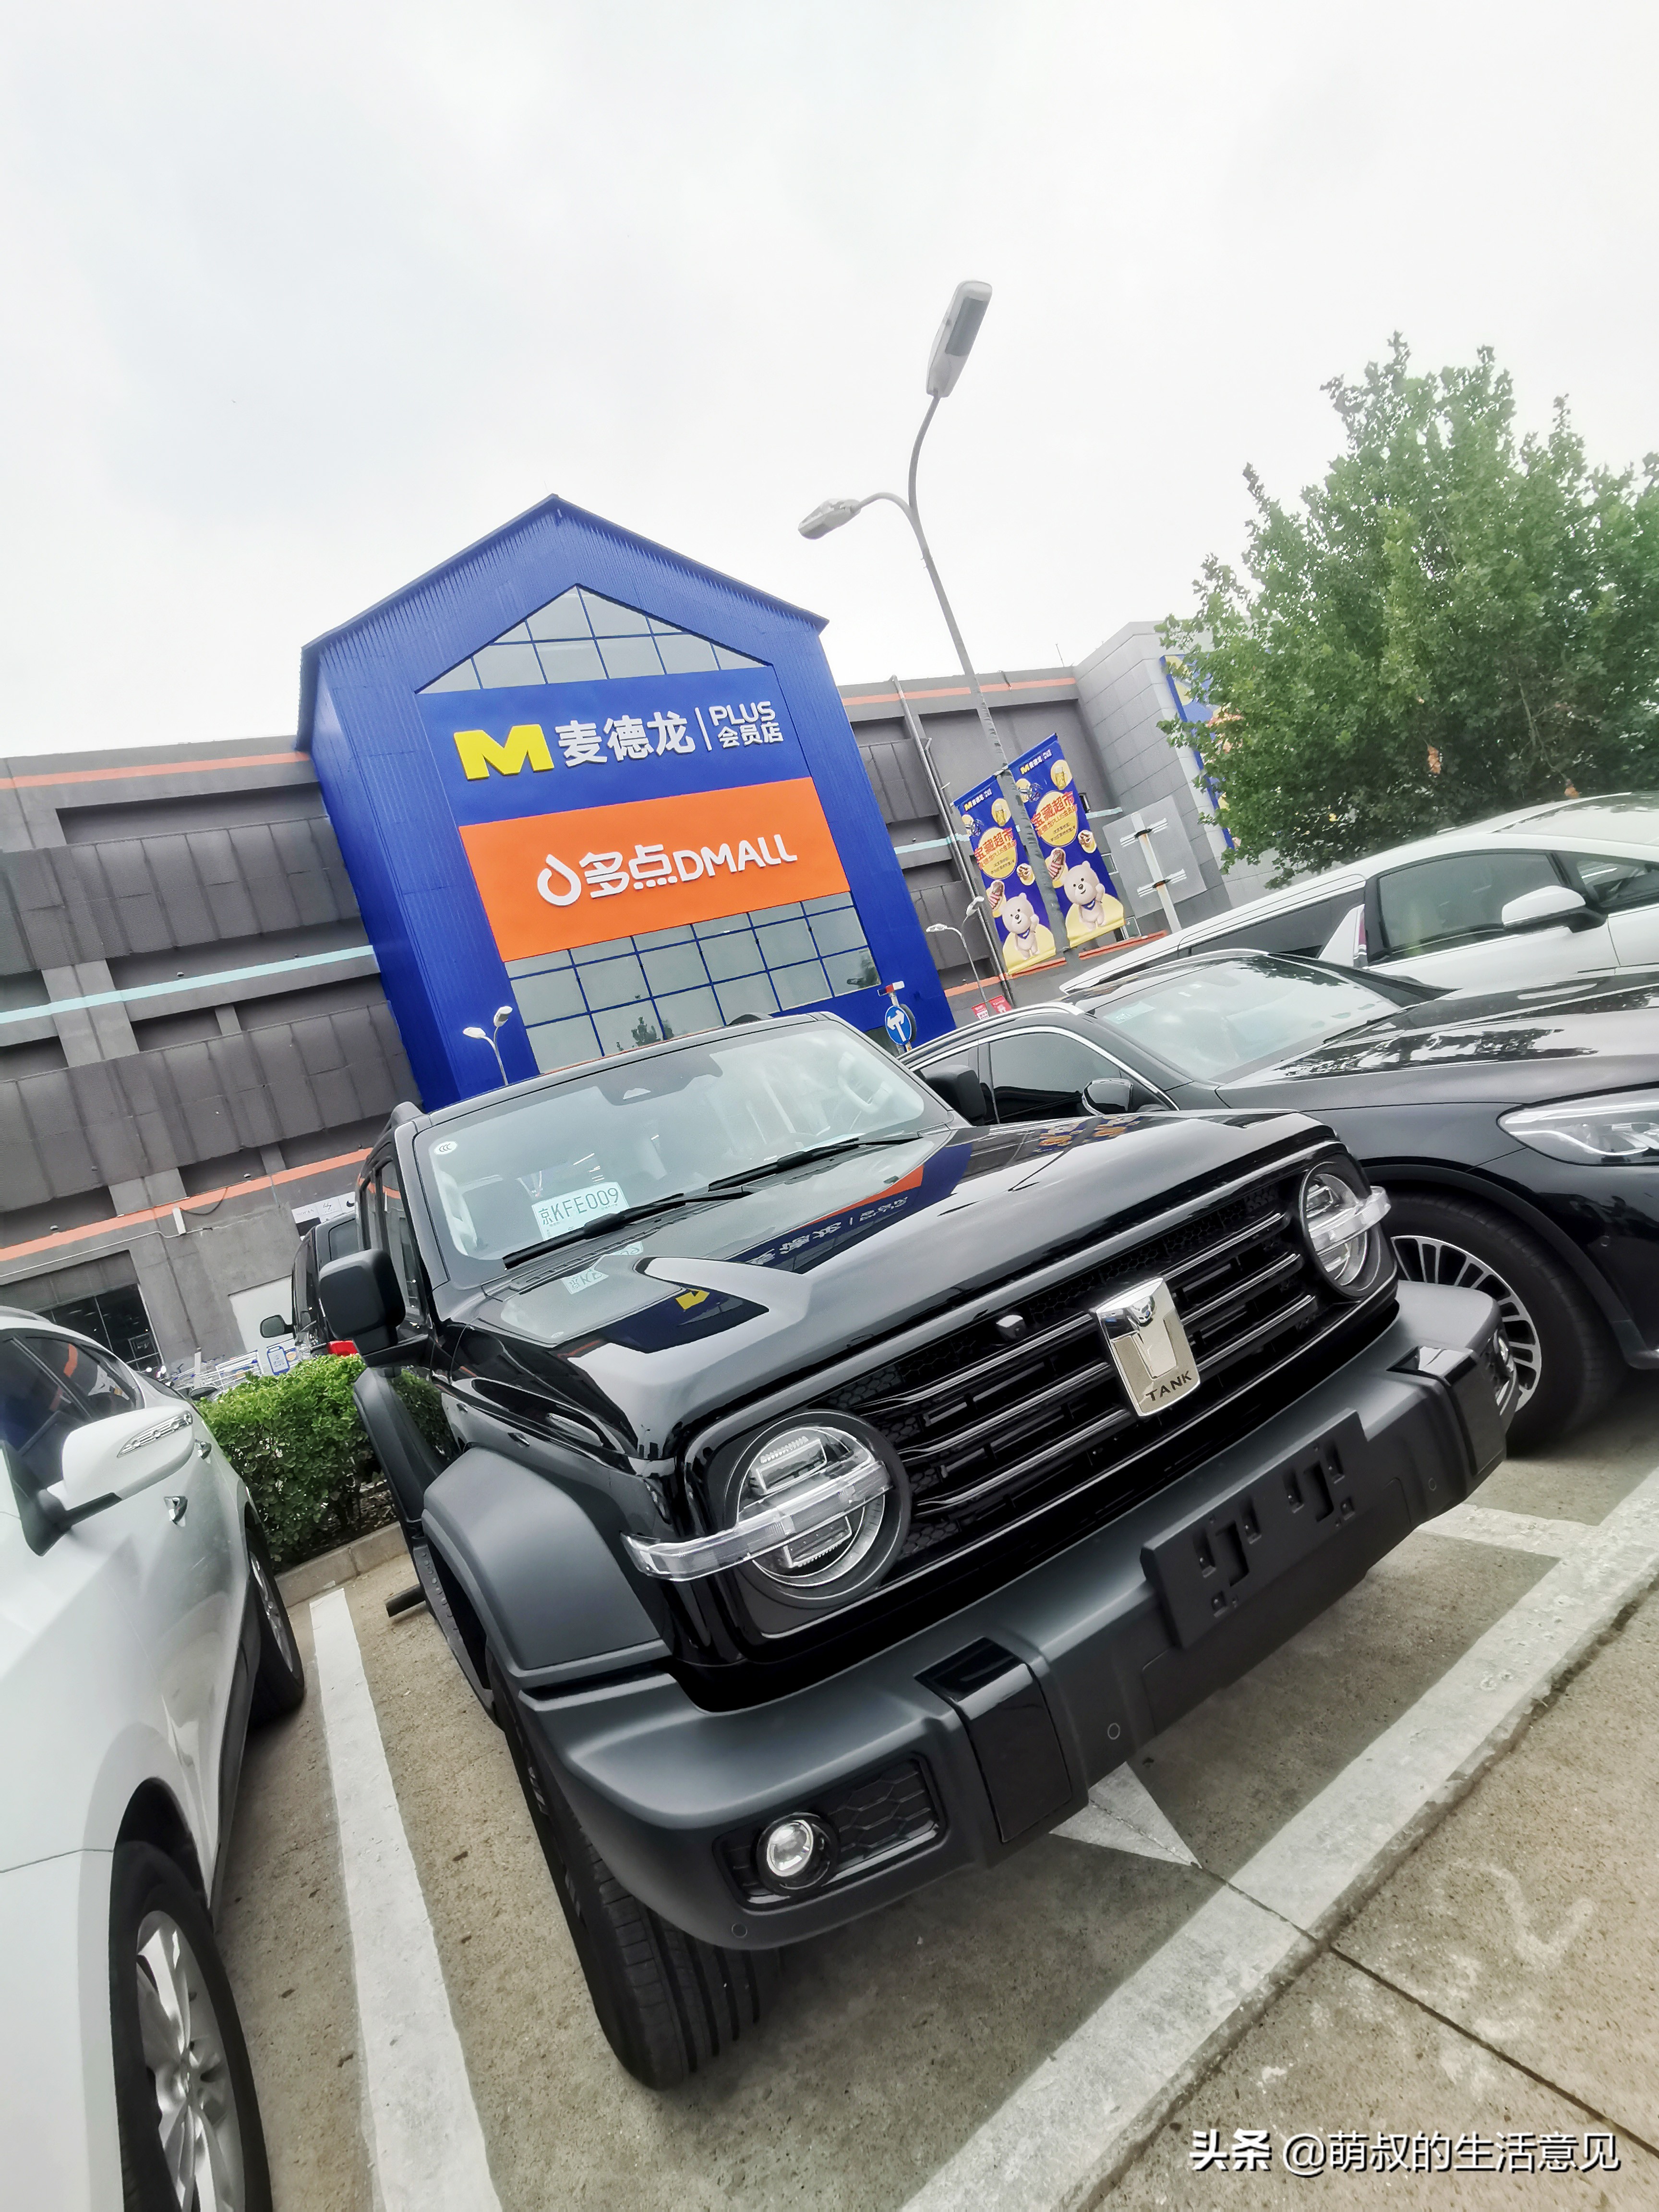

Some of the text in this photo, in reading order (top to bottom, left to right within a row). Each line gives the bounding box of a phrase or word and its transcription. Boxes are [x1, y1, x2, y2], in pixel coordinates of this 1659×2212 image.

[709, 700, 776, 726] PLUS
[453, 710, 696, 781] M 麦德龙
[717, 723, 784, 749] 会员店
[538, 1188, 619, 1226] 京KFE009
[1145, 1370, 1192, 1401] TANK
